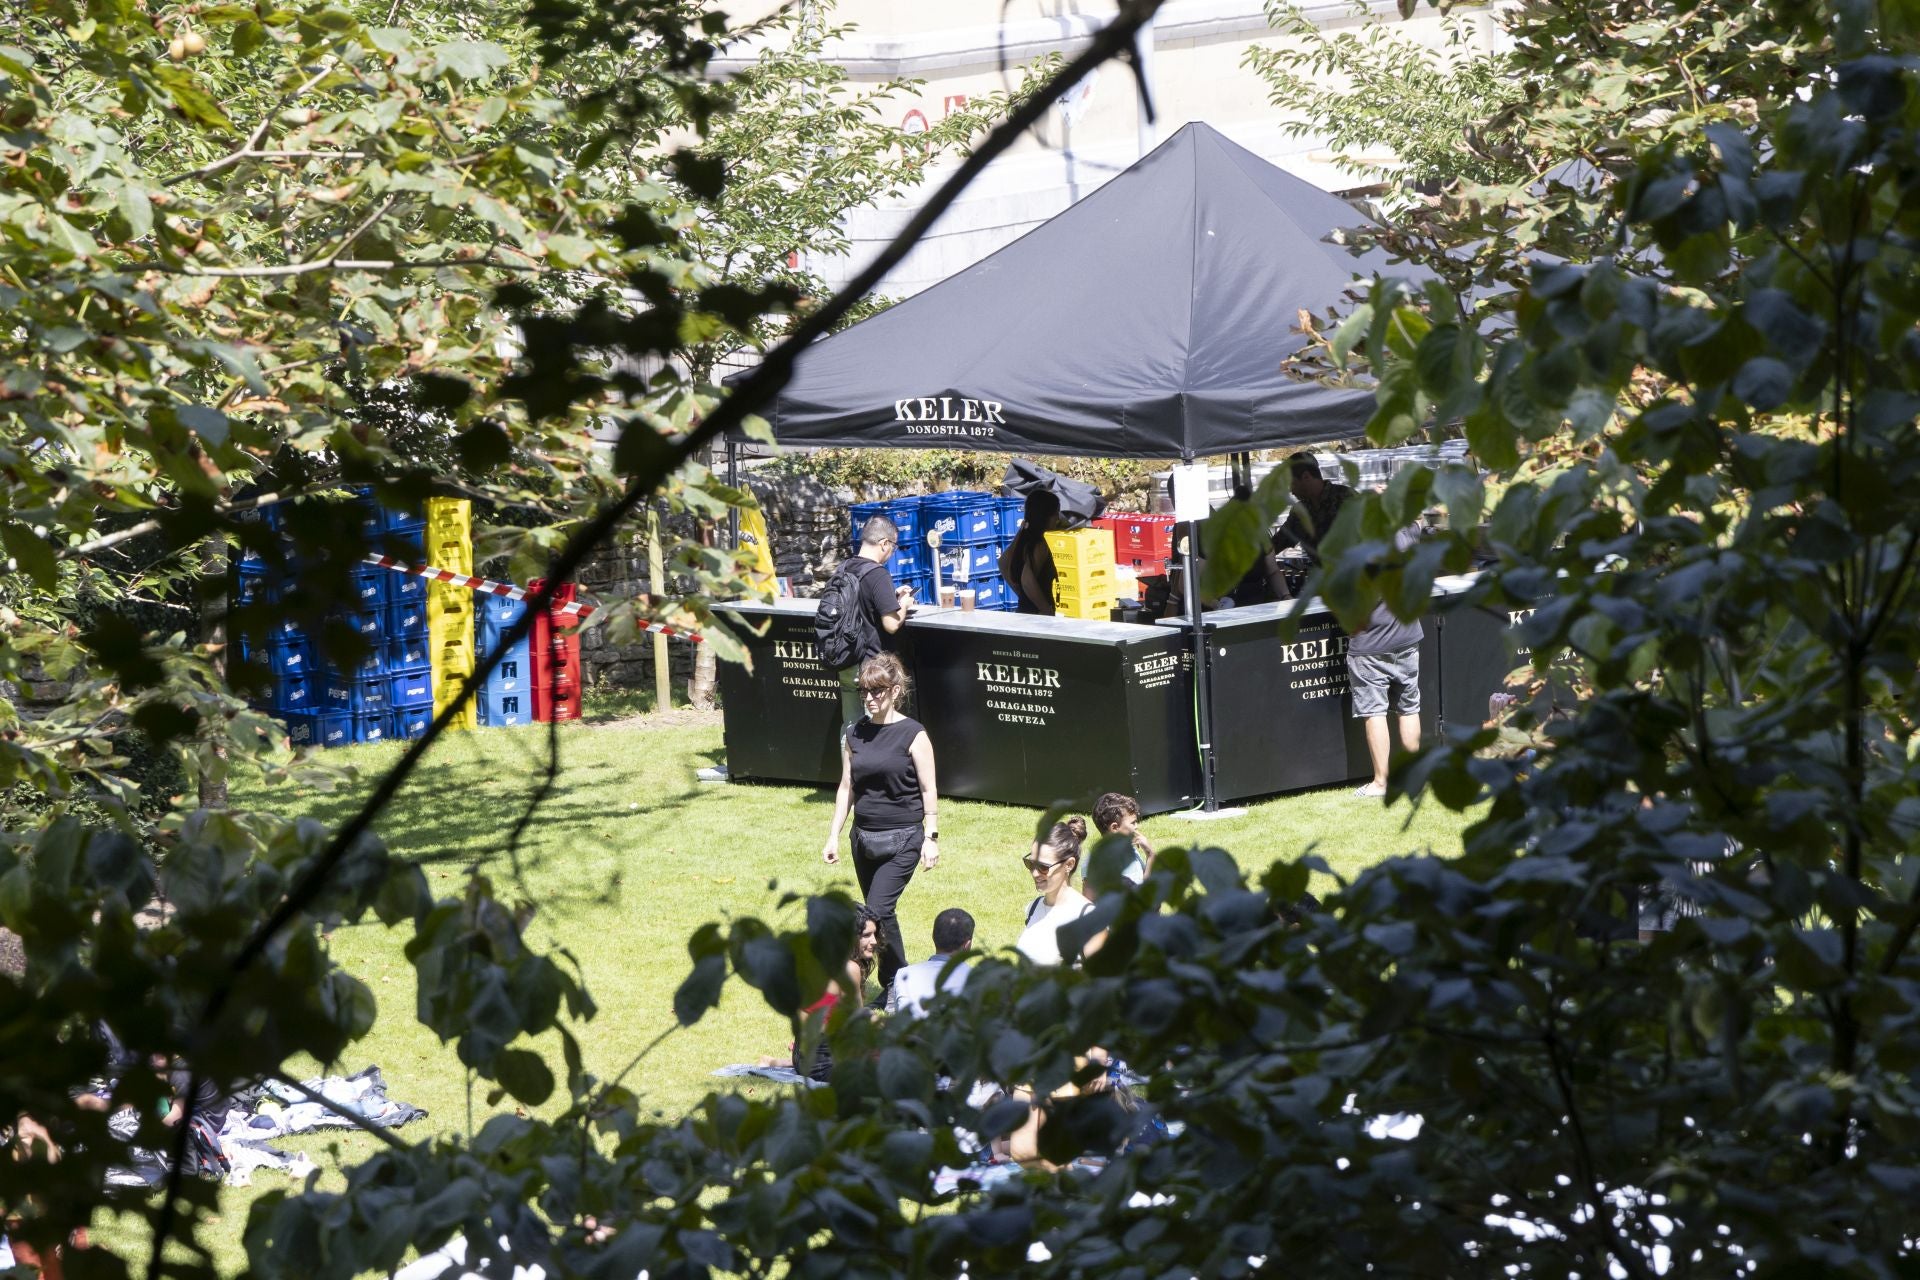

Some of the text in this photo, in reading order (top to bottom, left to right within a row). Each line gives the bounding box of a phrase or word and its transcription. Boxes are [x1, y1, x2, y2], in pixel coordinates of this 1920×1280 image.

[894, 397, 1006, 424] KELER
[906, 425, 994, 436] DONOSTIA 1872
[774, 640, 825, 661] KEL
[1013, 650, 1020, 658] 18
[1280, 635, 1350, 664] KELE
[783, 661, 825, 671] DONOSTI
[1133, 655, 1179, 674] KELER
[1291, 659, 1341, 673] DONOSTIA
[782, 676, 840, 688] GARAGARDO
[976, 662, 1061, 688] KELER
[1290, 673, 1350, 689] GARAGARD
[792, 689, 837, 700] CERVEZA
[987, 684, 1053, 697] DONOSTIA 1872
[986, 699, 1055, 714] GARAGARDOA
[998, 713, 1046, 726] CERVEZA
